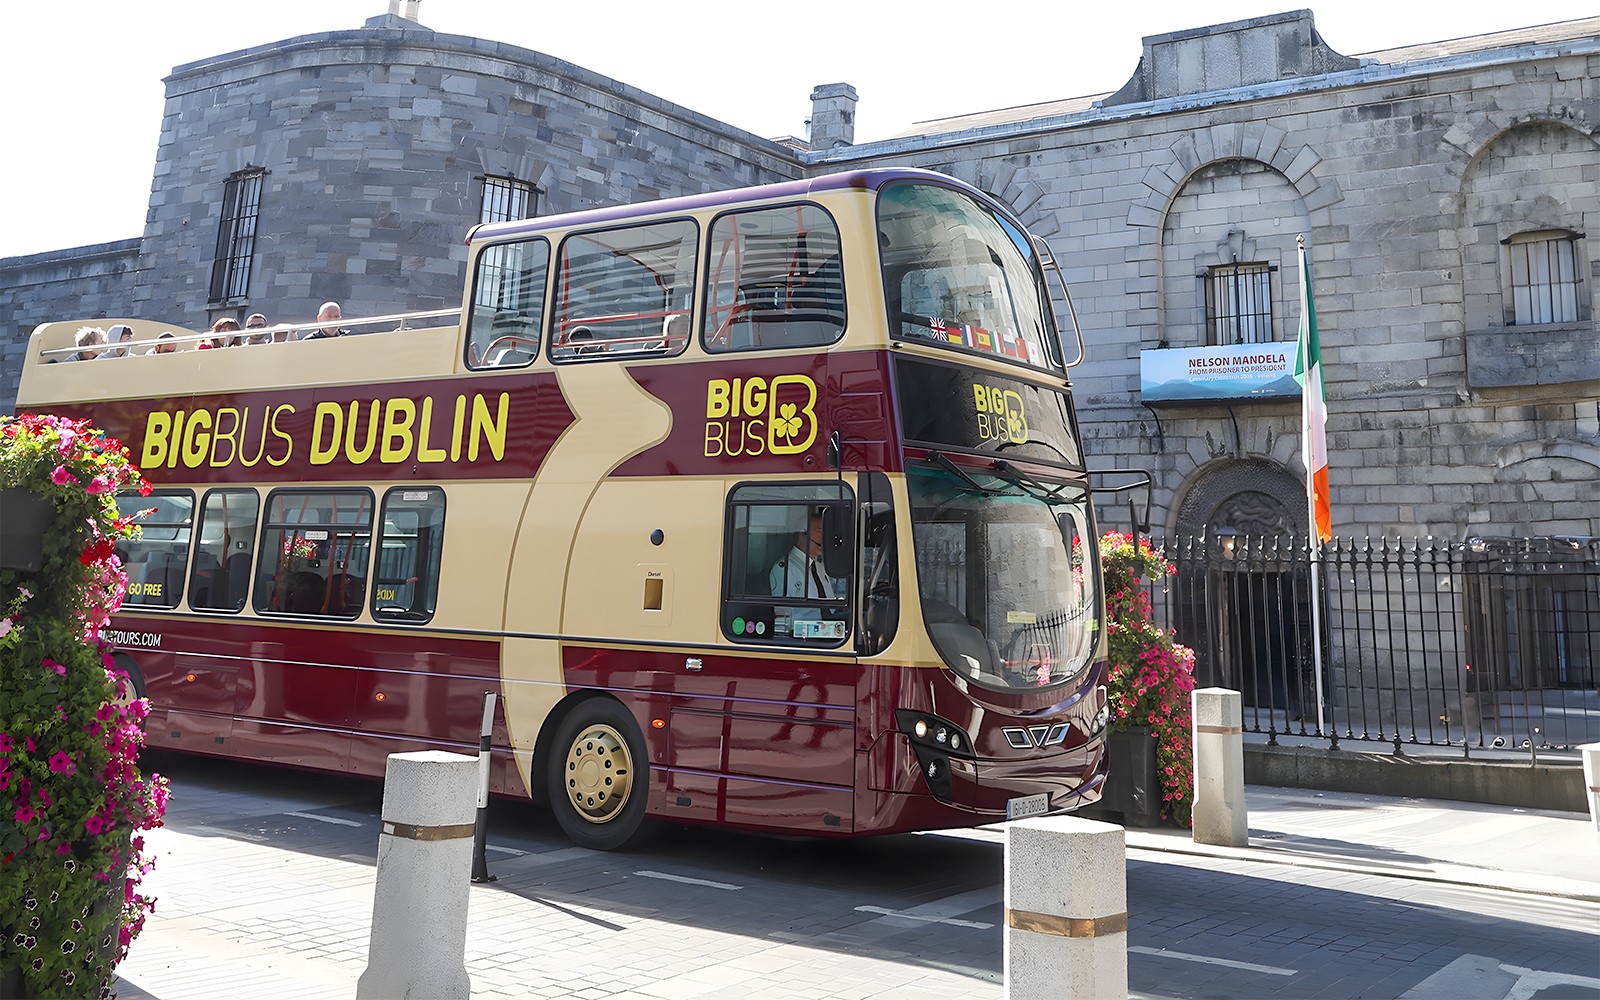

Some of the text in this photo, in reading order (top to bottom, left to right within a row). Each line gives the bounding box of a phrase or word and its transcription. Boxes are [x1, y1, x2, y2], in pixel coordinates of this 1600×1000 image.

[1188, 353, 1286, 368] NELSON MANDELA
[706, 376, 768, 419] BIG
[972, 383, 1005, 415] BIG
[308, 391, 510, 466] DUBLIN
[703, 419, 766, 457] BUS
[977, 413, 1009, 442] BUS
[128, 583, 142, 595] GO
[143, 583, 162, 596] FREE
